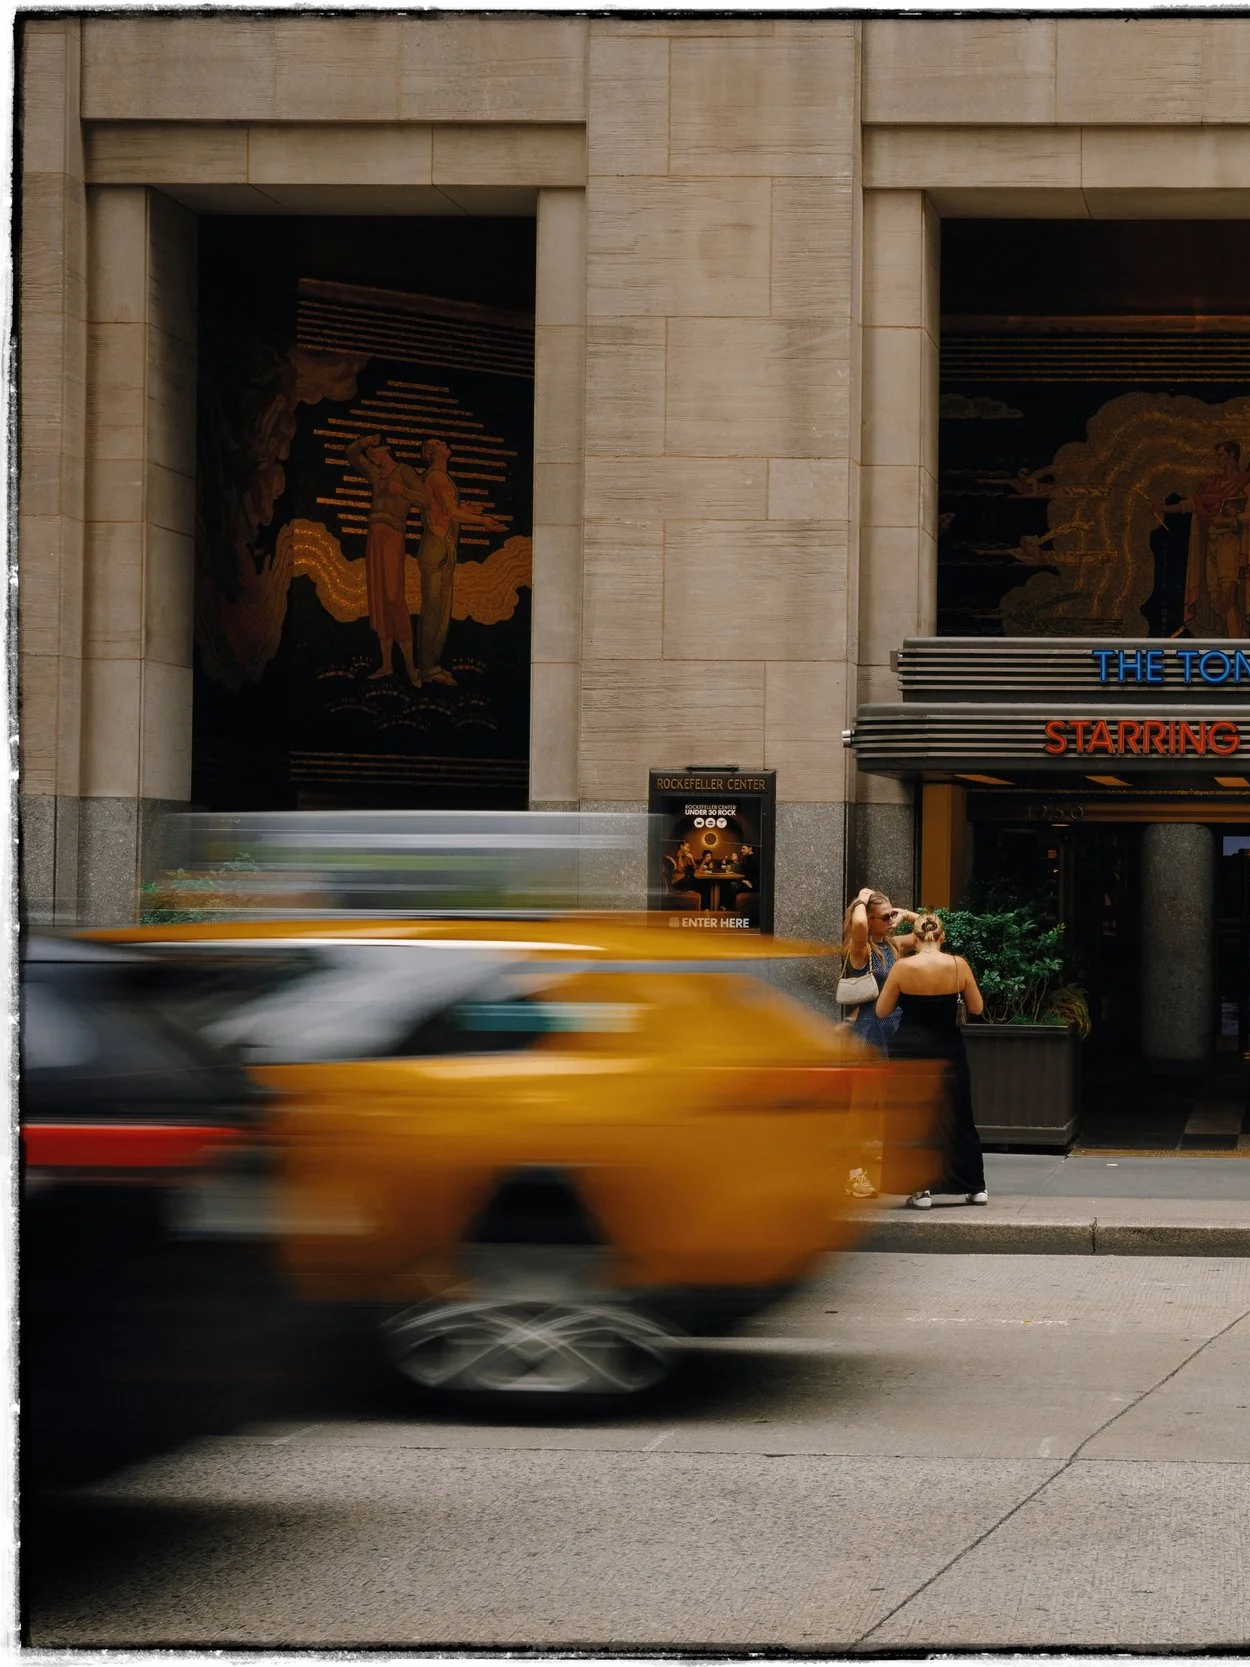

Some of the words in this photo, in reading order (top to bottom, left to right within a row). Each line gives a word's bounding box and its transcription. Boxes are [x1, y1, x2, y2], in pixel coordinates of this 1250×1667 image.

[1092, 650, 1164, 683] THE
[1043, 720, 1241, 755] STARRING
[656, 778, 723, 790] ROCKEFELLER
[727, 778, 766, 790] CENTER
[1027, 804, 1085, 821] 1250
[681, 917, 718, 928] ENTER
[720, 917, 750, 928] HERE
